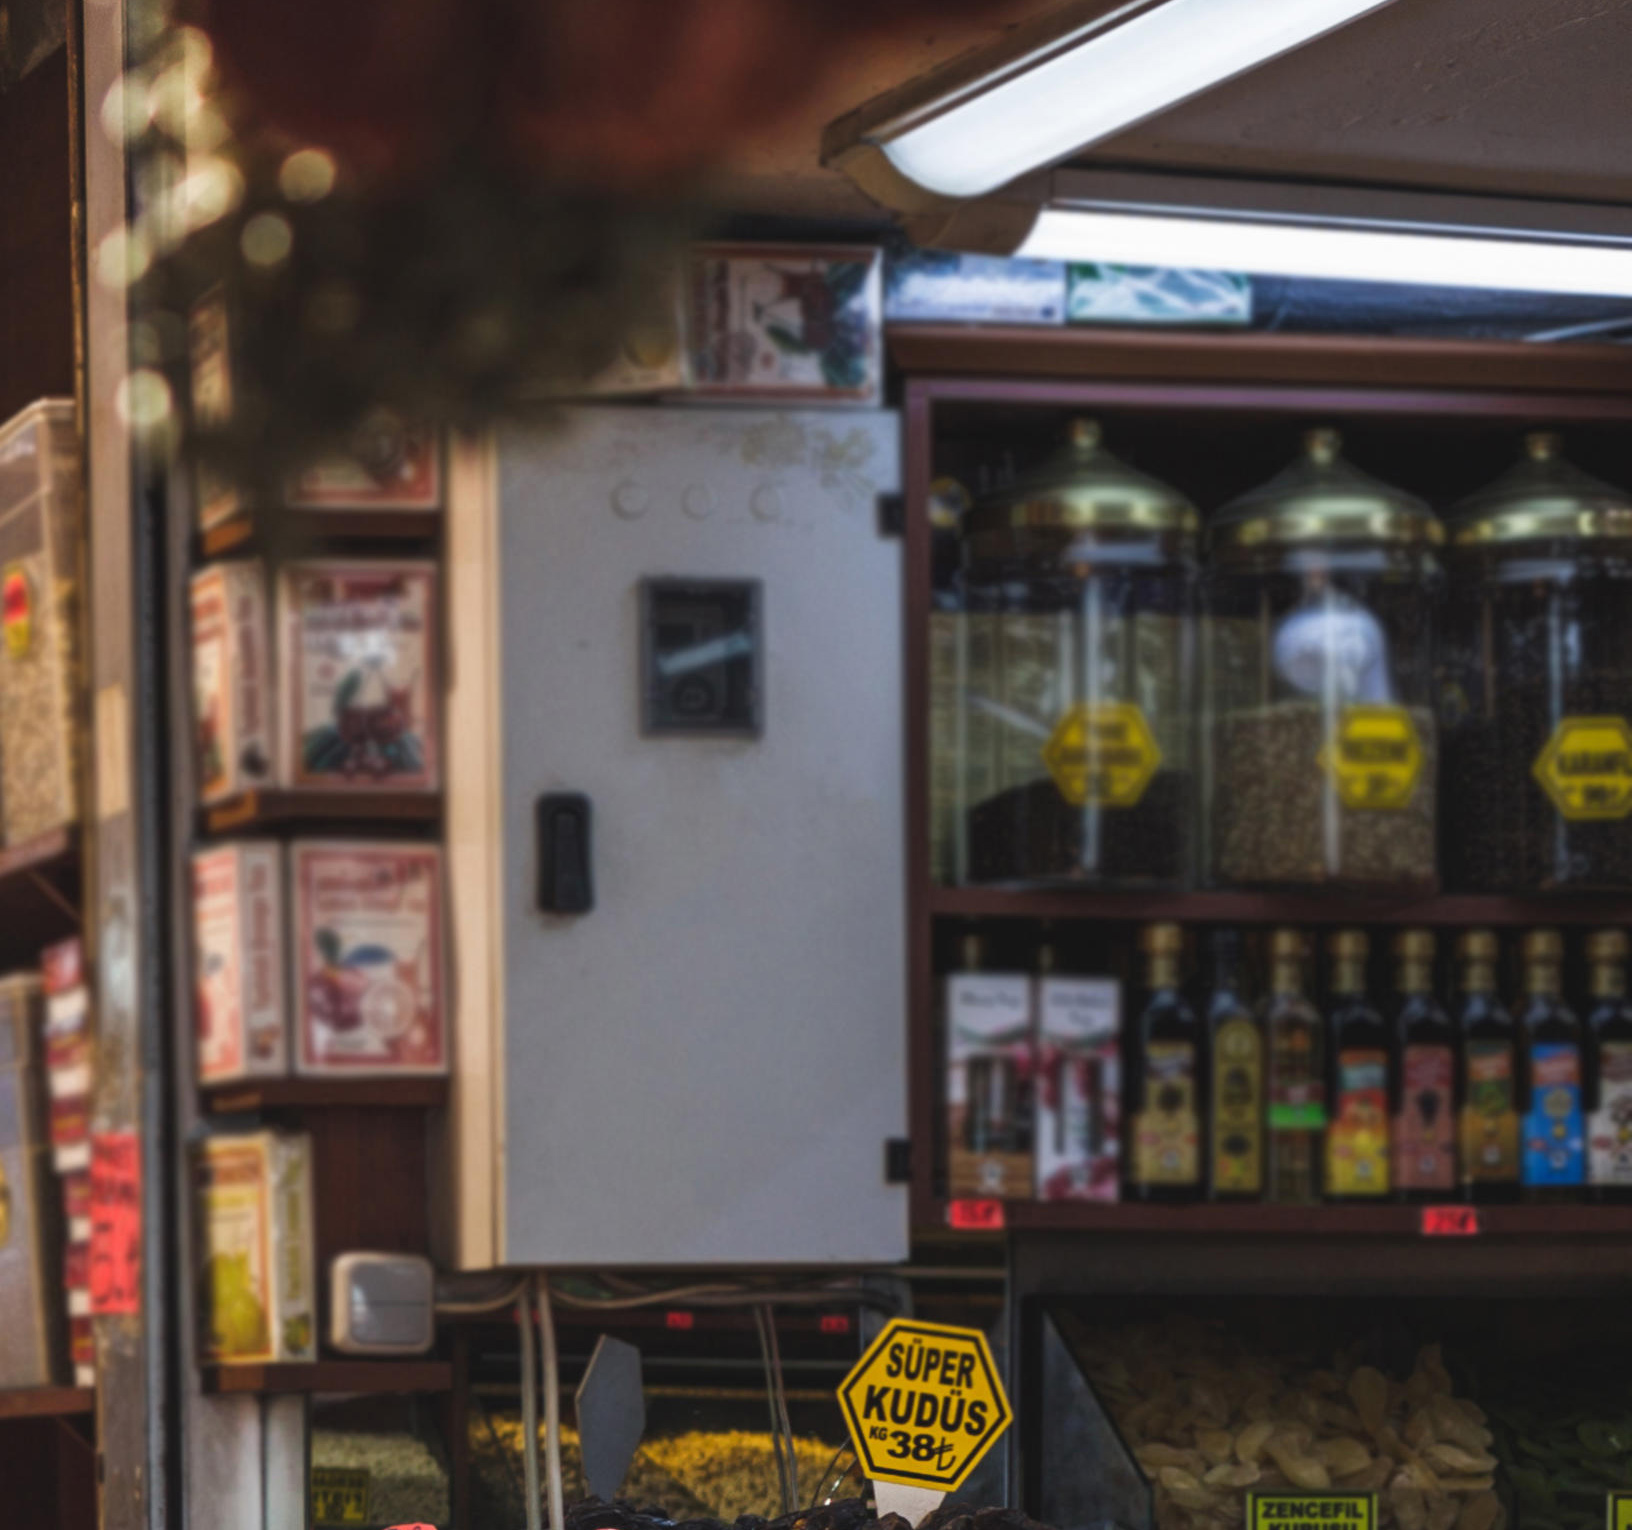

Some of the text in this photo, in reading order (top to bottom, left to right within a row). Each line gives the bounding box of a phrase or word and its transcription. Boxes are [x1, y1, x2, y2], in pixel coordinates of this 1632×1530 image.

[886, 1338, 975, 1389] SÜPER
[863, 1384, 988, 1436] KUDÜS
[869, 1425, 887, 1441] KG
